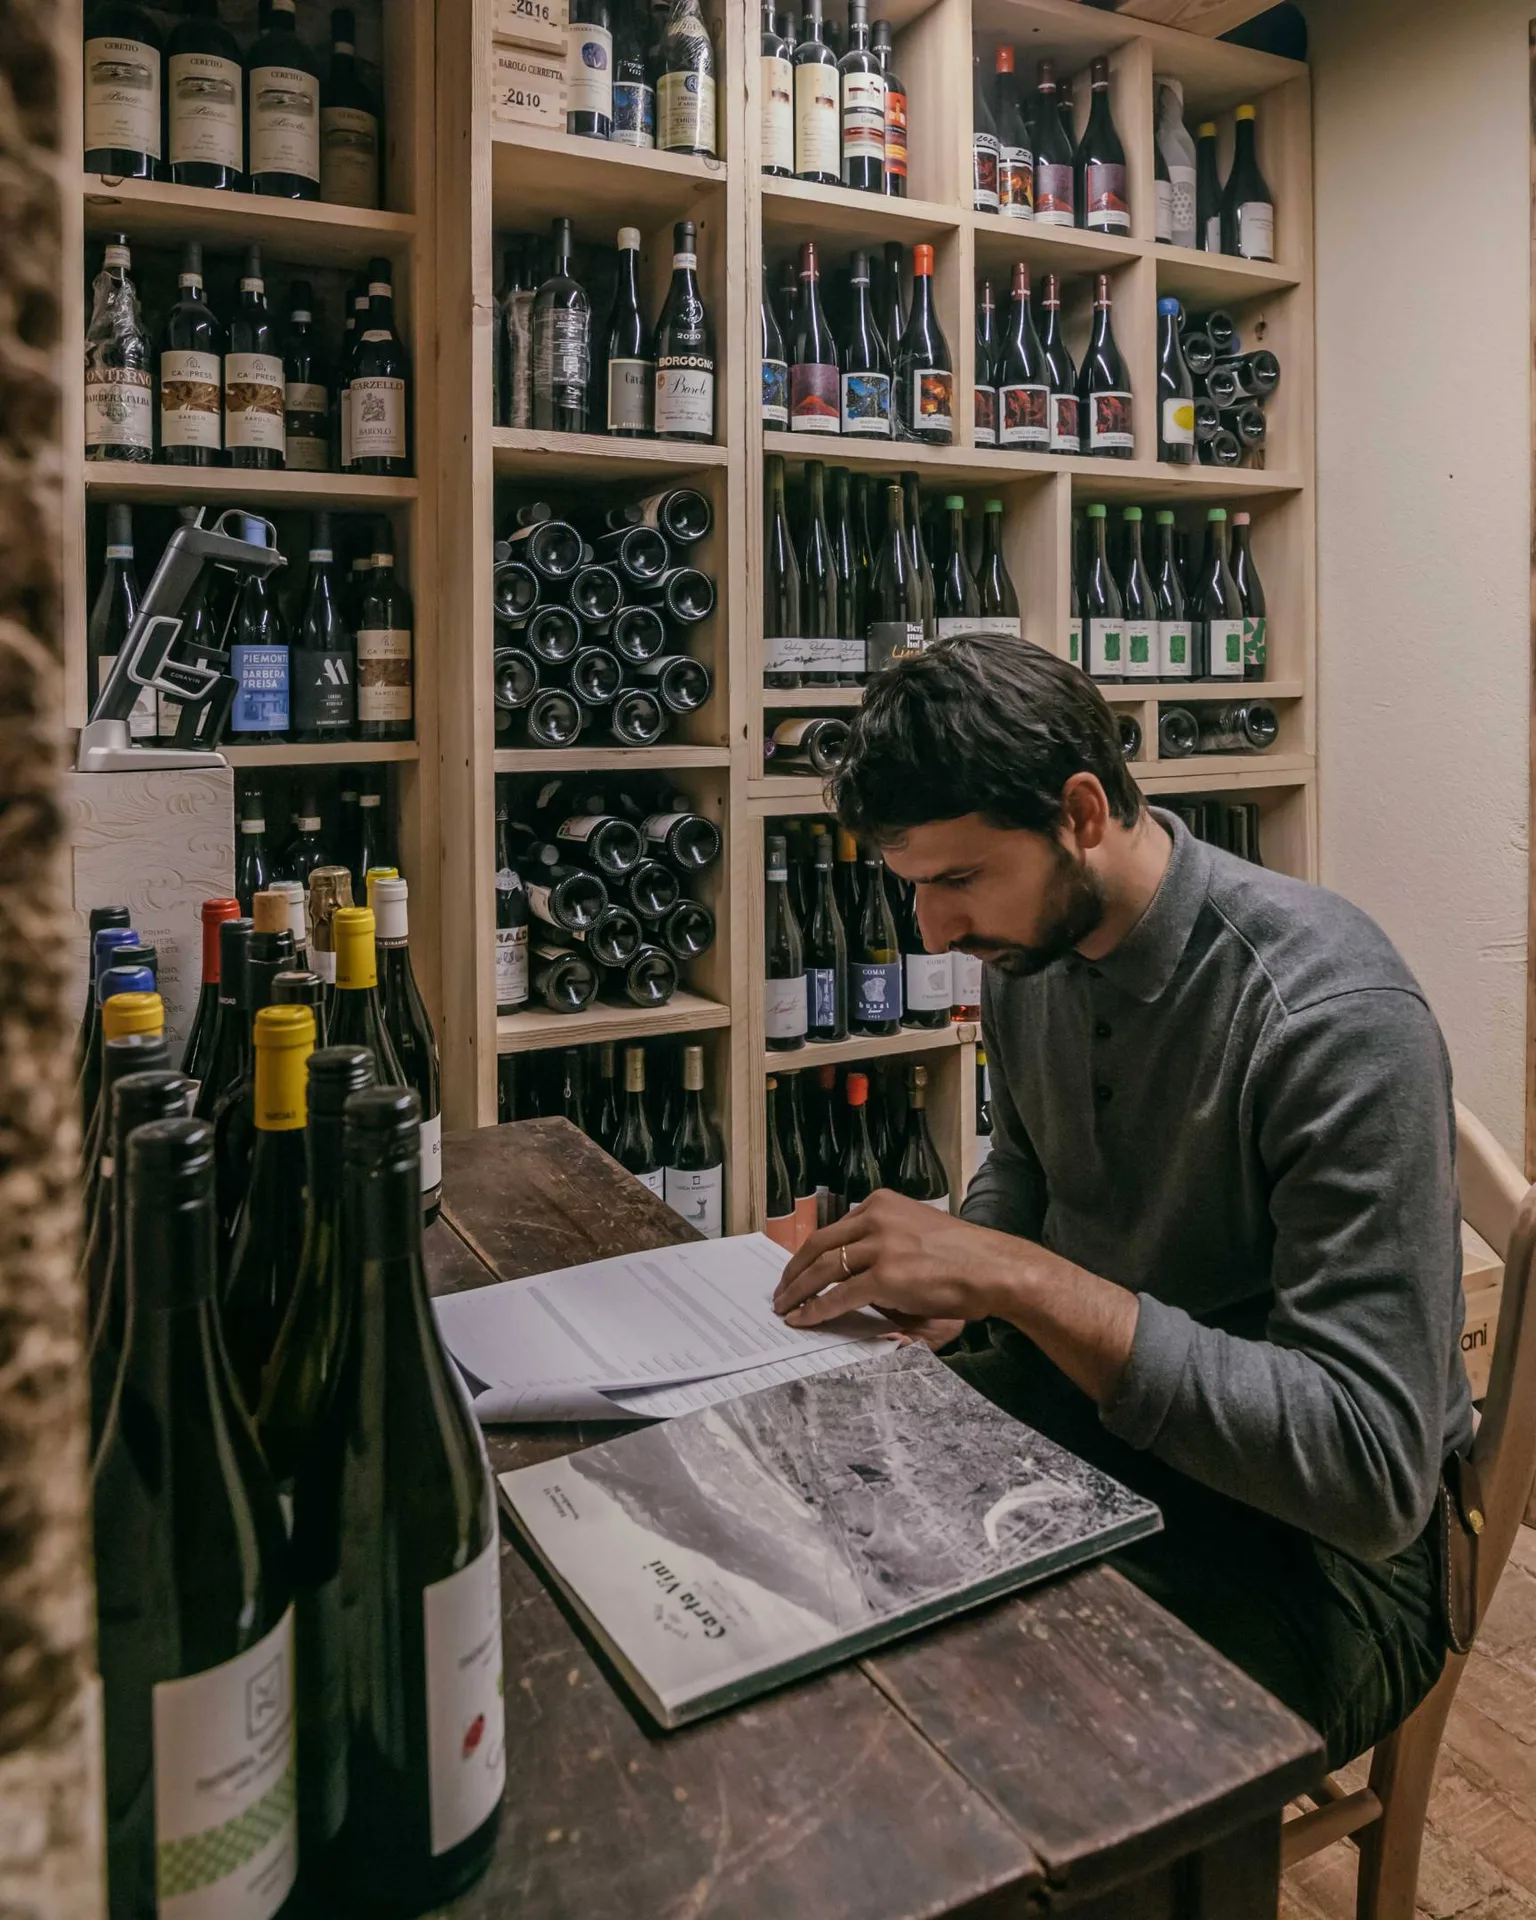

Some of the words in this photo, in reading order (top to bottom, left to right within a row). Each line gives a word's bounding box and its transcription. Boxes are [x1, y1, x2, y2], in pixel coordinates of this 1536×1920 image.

[516, 0, 550, 20] 2016
[498, 58, 528, 72] BAROLO
[527, 65, 564, 80] CERRETTA
[507, 87, 541, 108] 2010
[677, 332, 701, 340] 2020
[659, 356, 714, 370] BORGOGNO
[189, 371, 213, 380] PRESS
[255, 373, 277, 382] PRESS
[358, 426, 392, 436] BAROLO
[169, 671, 201, 684] CORAVIN
[243, 669, 286, 679] BARBERA
[242, 680, 278, 689] FREISA
[642, 1560, 681, 1595] Vini
[680, 1592, 726, 1639] Carta
